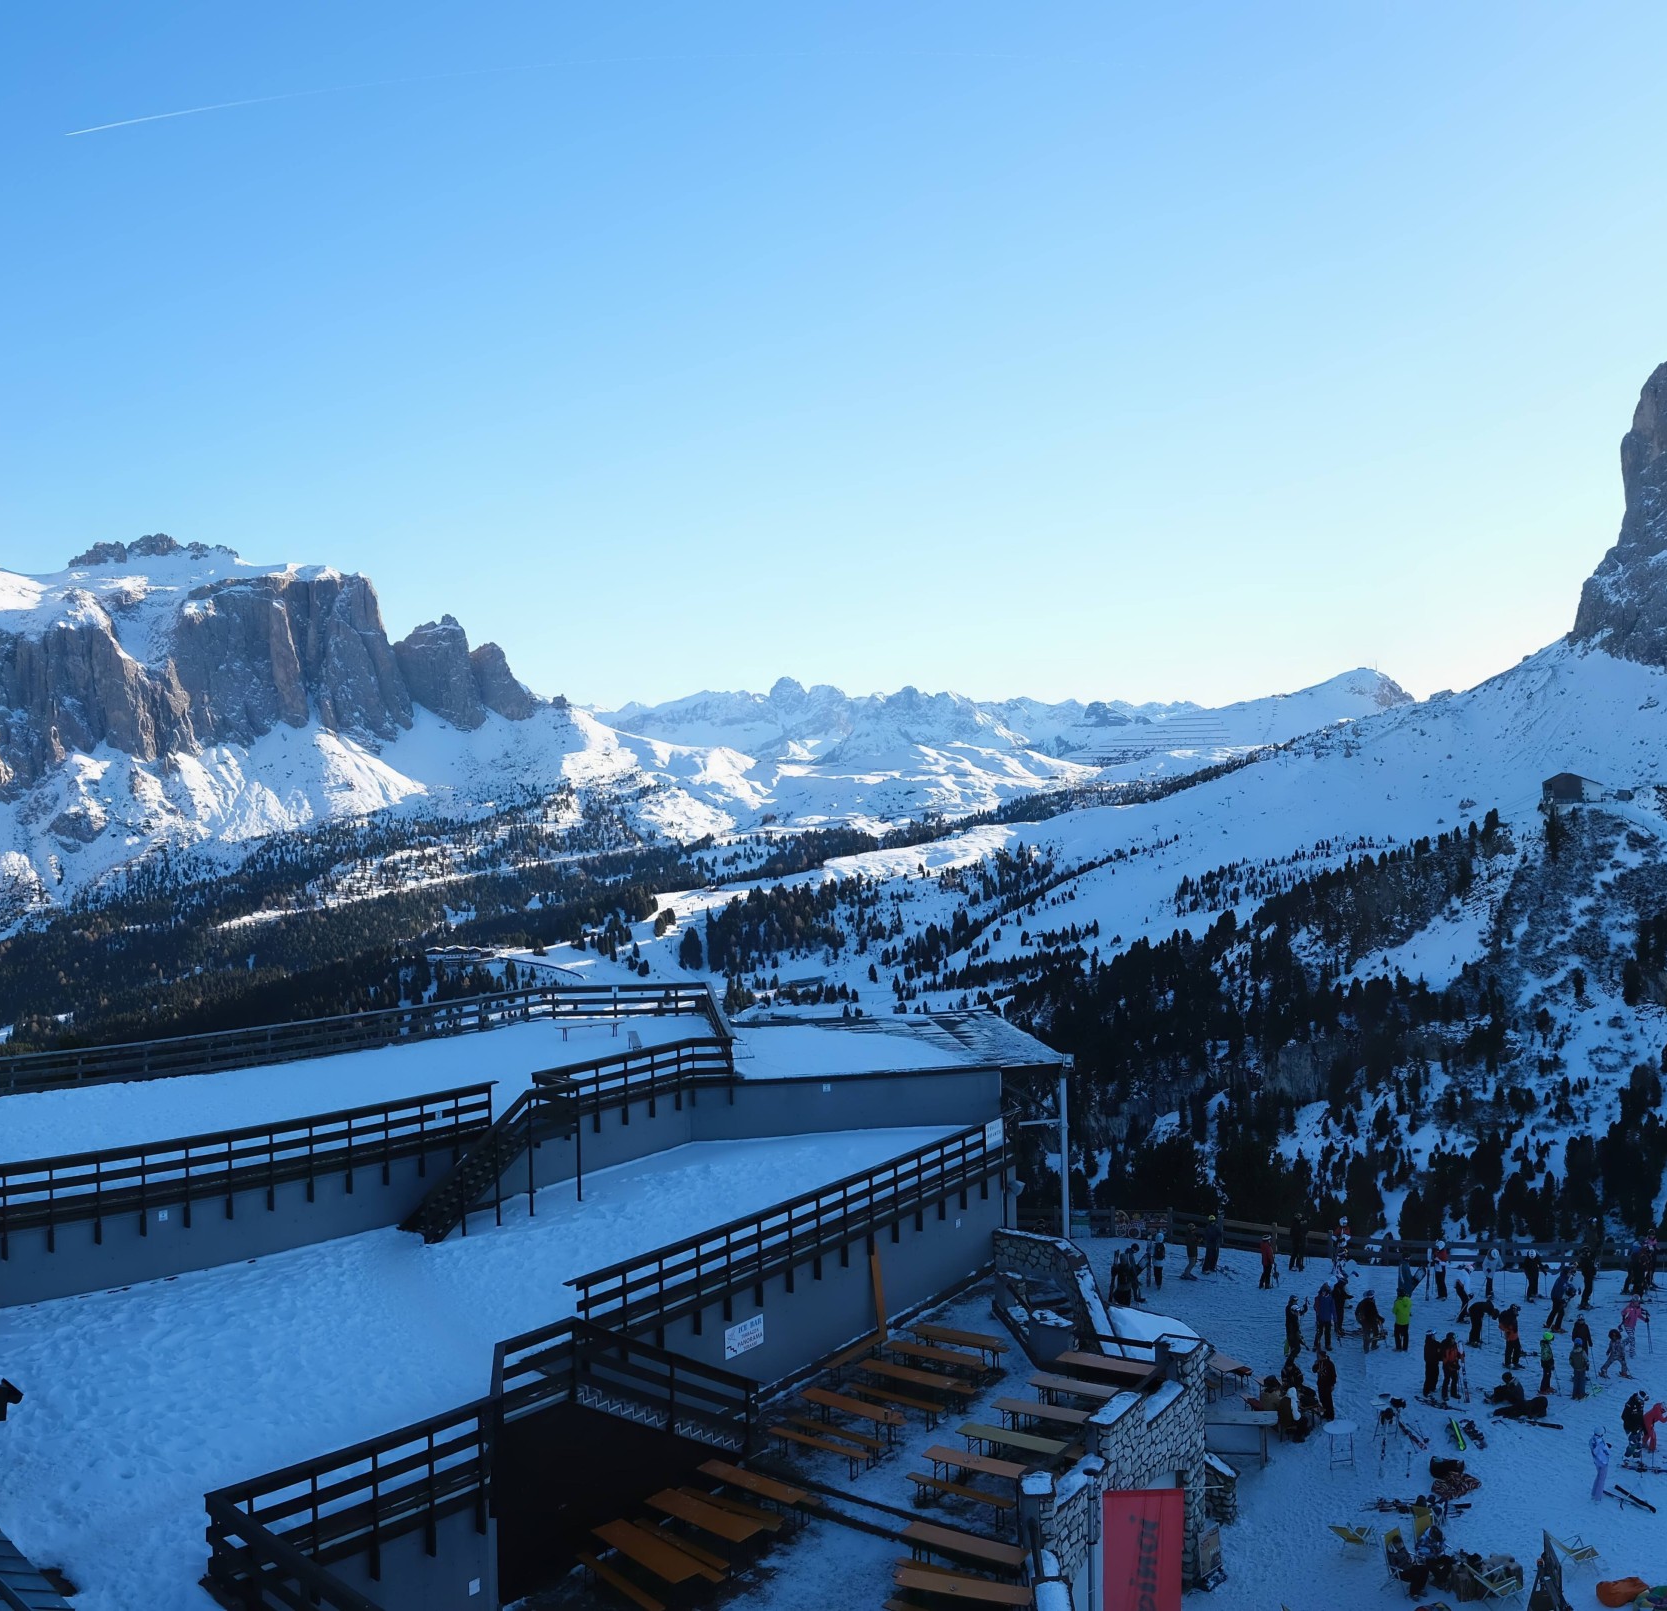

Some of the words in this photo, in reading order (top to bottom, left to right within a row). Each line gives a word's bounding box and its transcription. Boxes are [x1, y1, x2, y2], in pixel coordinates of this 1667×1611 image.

[738, 1324, 748, 1334] ICE
[750, 1318, 762, 1328] BAR
[738, 1332, 762, 1348] PANORAMA
